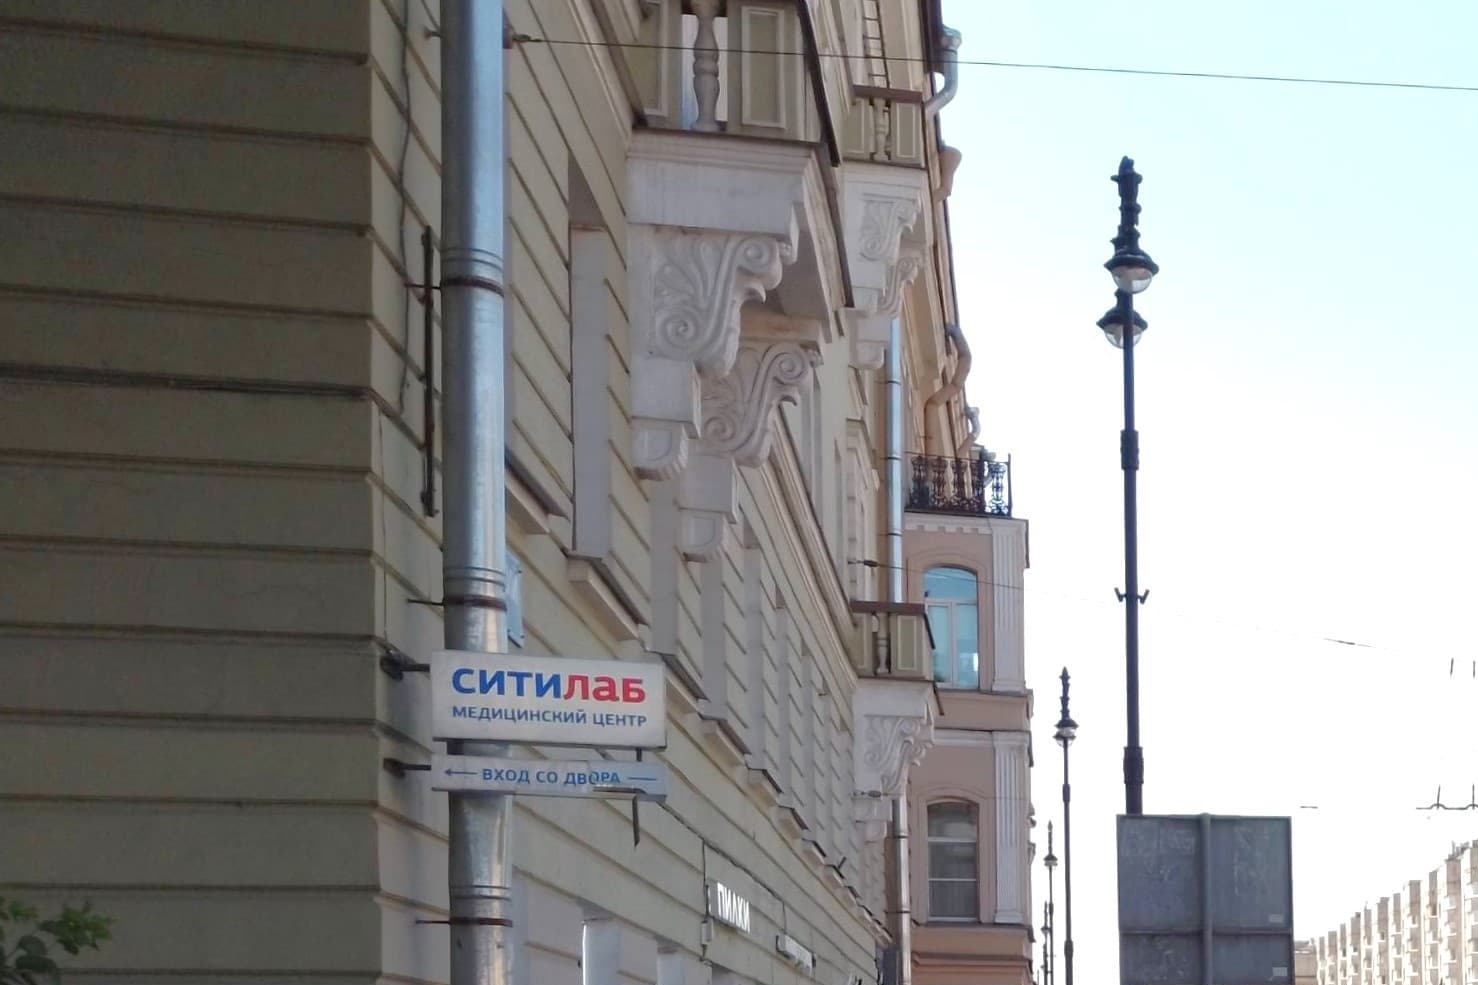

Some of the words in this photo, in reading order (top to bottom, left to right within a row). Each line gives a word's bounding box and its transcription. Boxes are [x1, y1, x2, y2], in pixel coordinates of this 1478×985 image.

[452, 705, 587, 724] МЕДИЦИНСКИЙ
[593, 712, 647, 728] ЦЕНТР
[482, 768, 530, 784] ВХОД
[536, 770, 558, 783] СО
[564, 770, 621, 786] ДВОРА
[717, 882, 751, 934] ПИЛКИ
